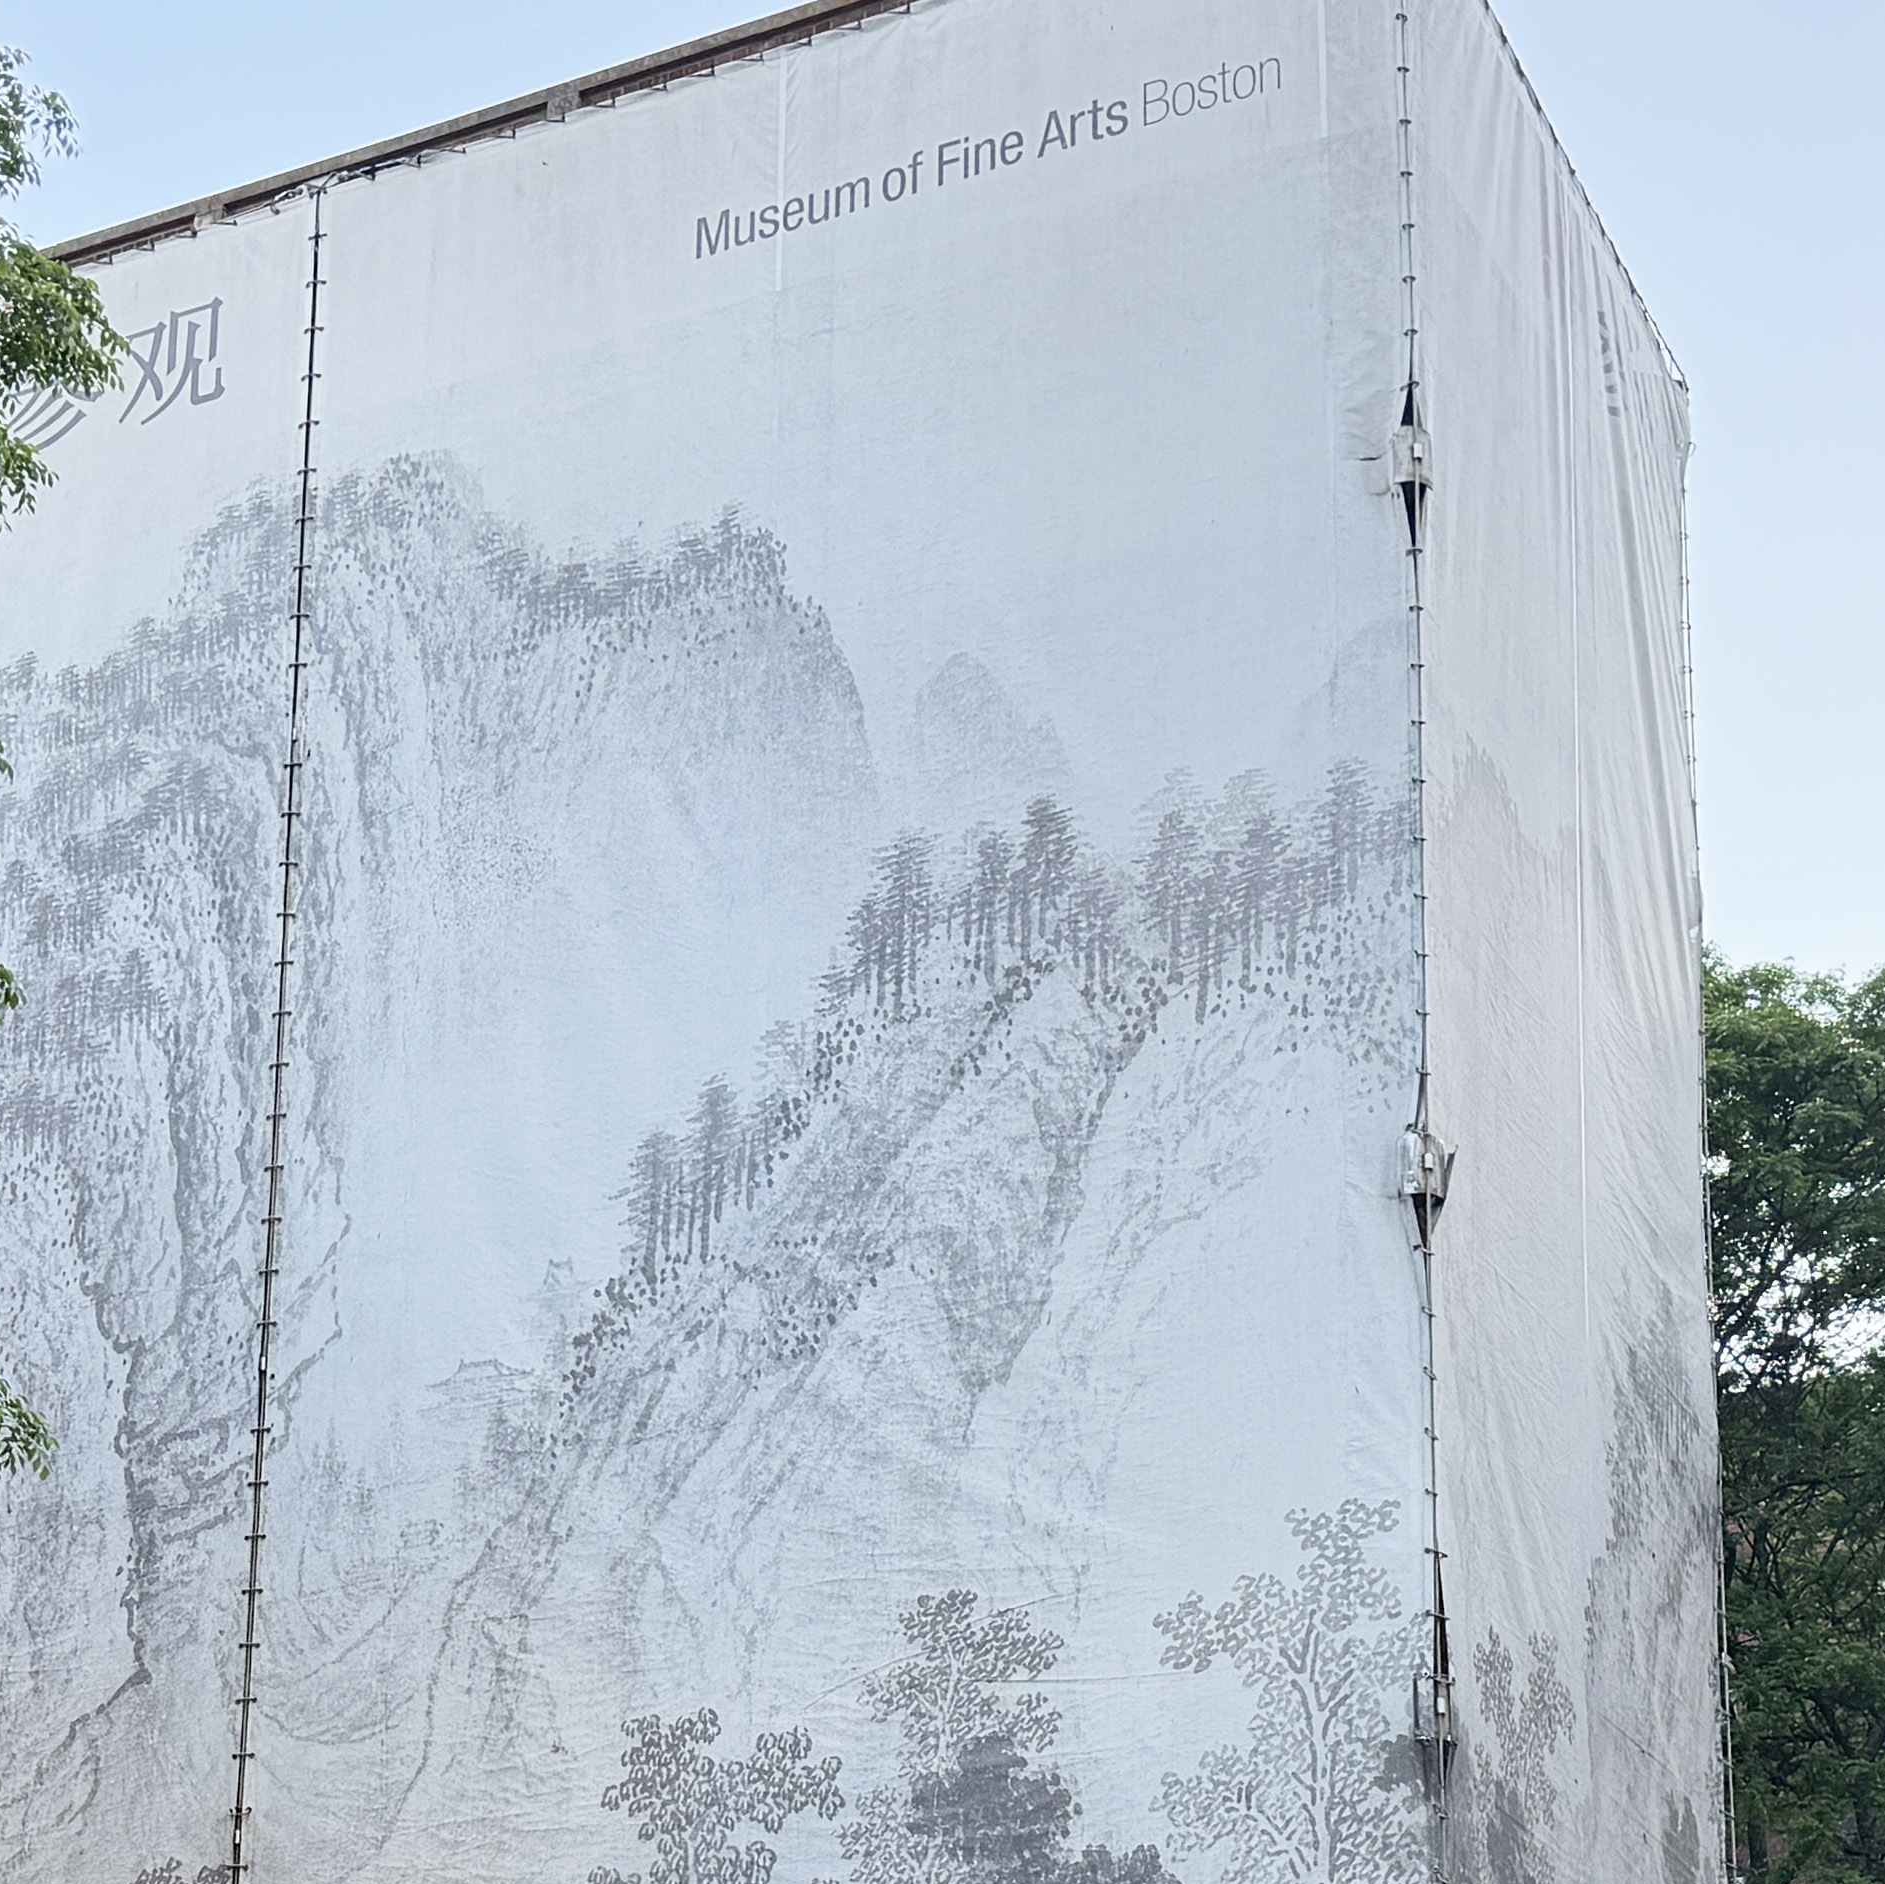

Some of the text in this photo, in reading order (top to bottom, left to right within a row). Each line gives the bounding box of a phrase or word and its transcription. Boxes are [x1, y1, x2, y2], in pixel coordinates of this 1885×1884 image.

[693, 56, 1282, 260] Museum of Fine Arts Boston
